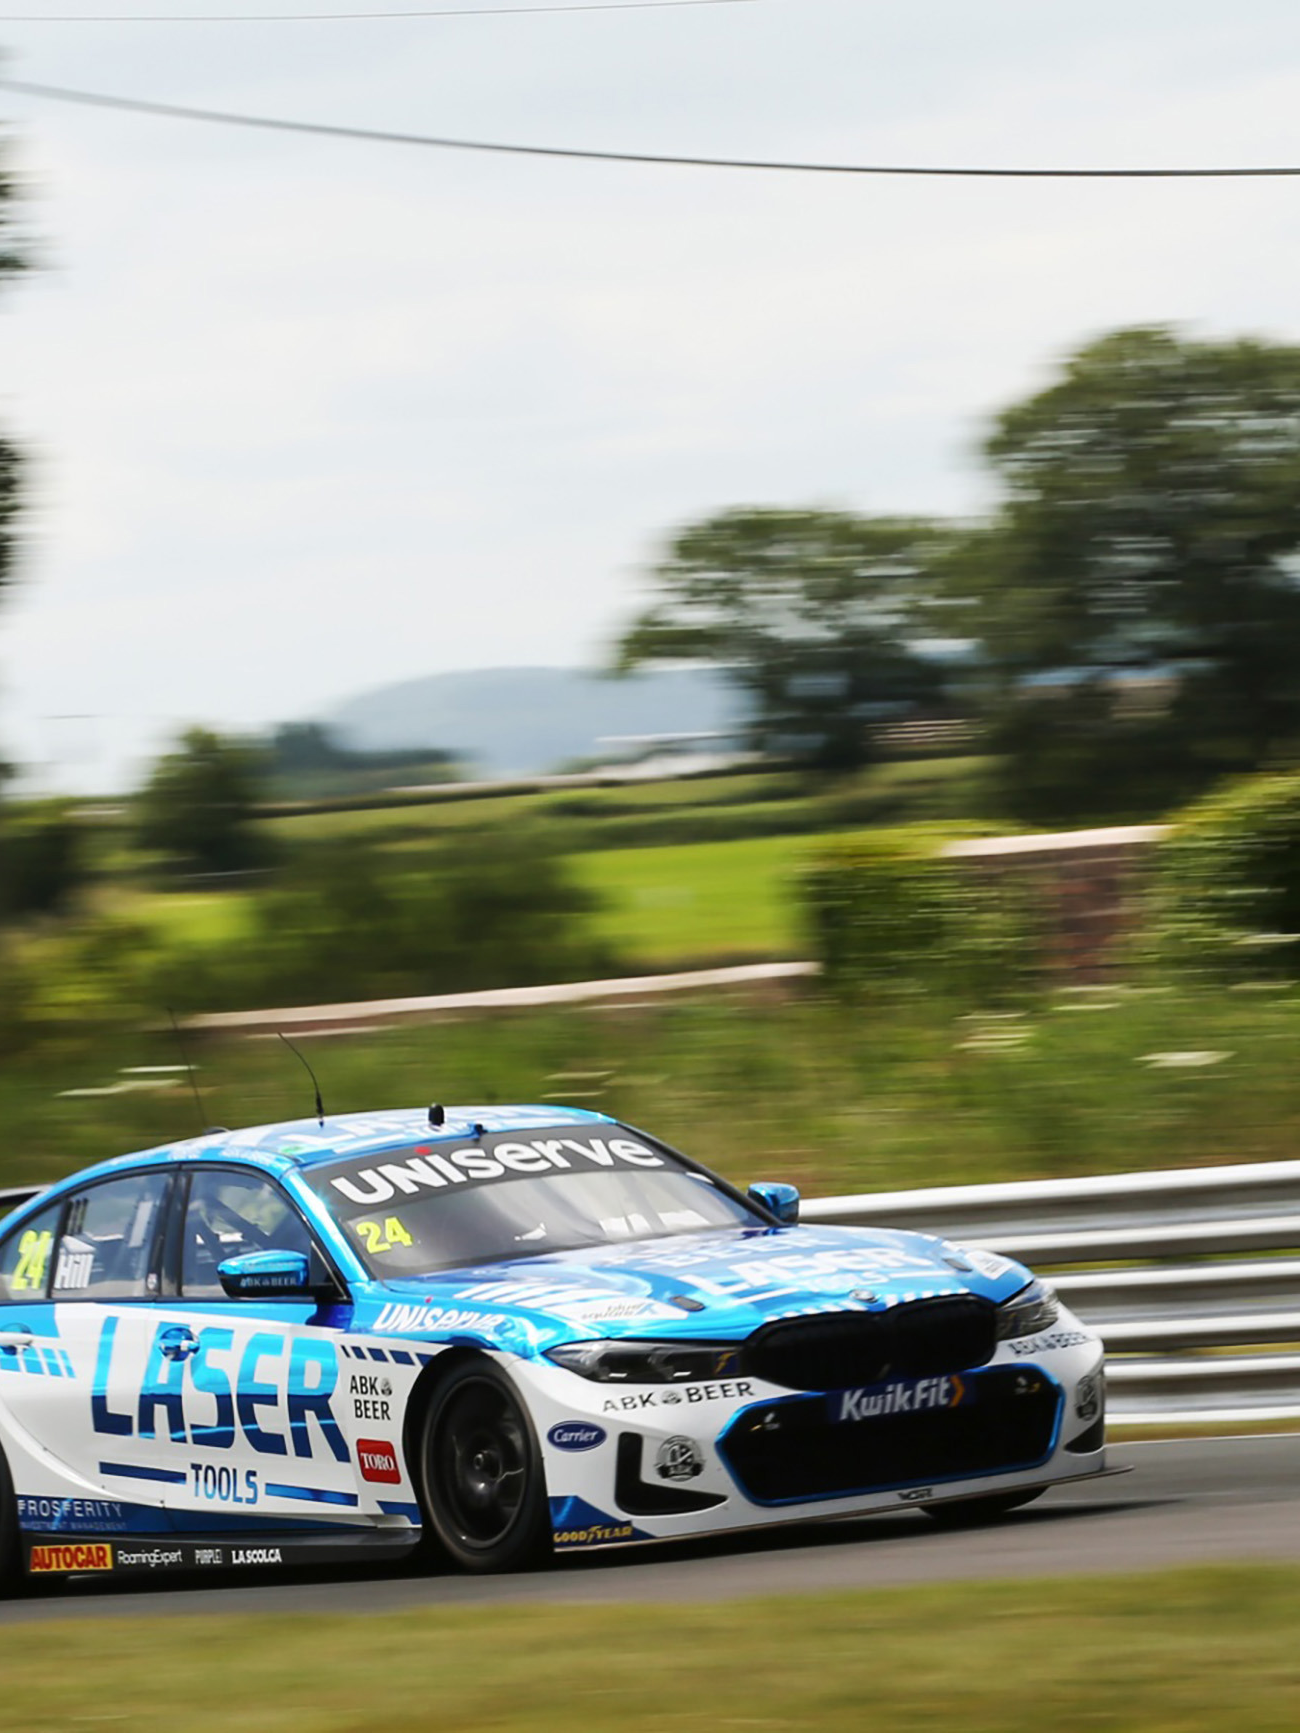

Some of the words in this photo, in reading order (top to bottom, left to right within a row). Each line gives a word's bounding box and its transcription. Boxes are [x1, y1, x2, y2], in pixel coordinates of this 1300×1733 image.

[356, 1217, 412, 1254] 24
[11, 1230, 52, 1290] 24
[91, 1316, 352, 1463] LASER
[350, 1375, 379, 1396] ABK
[602, 1391, 658, 1412] ABK
[685, 1381, 756, 1404] BEER
[354, 1399, 391, 1421] BEER
[553, 1428, 600, 1443] Carrier
[360, 1452, 395, 1471] TORO
[190, 1463, 258, 1504] TOOLS
[31, 1546, 108, 1570] AUTOCAR
